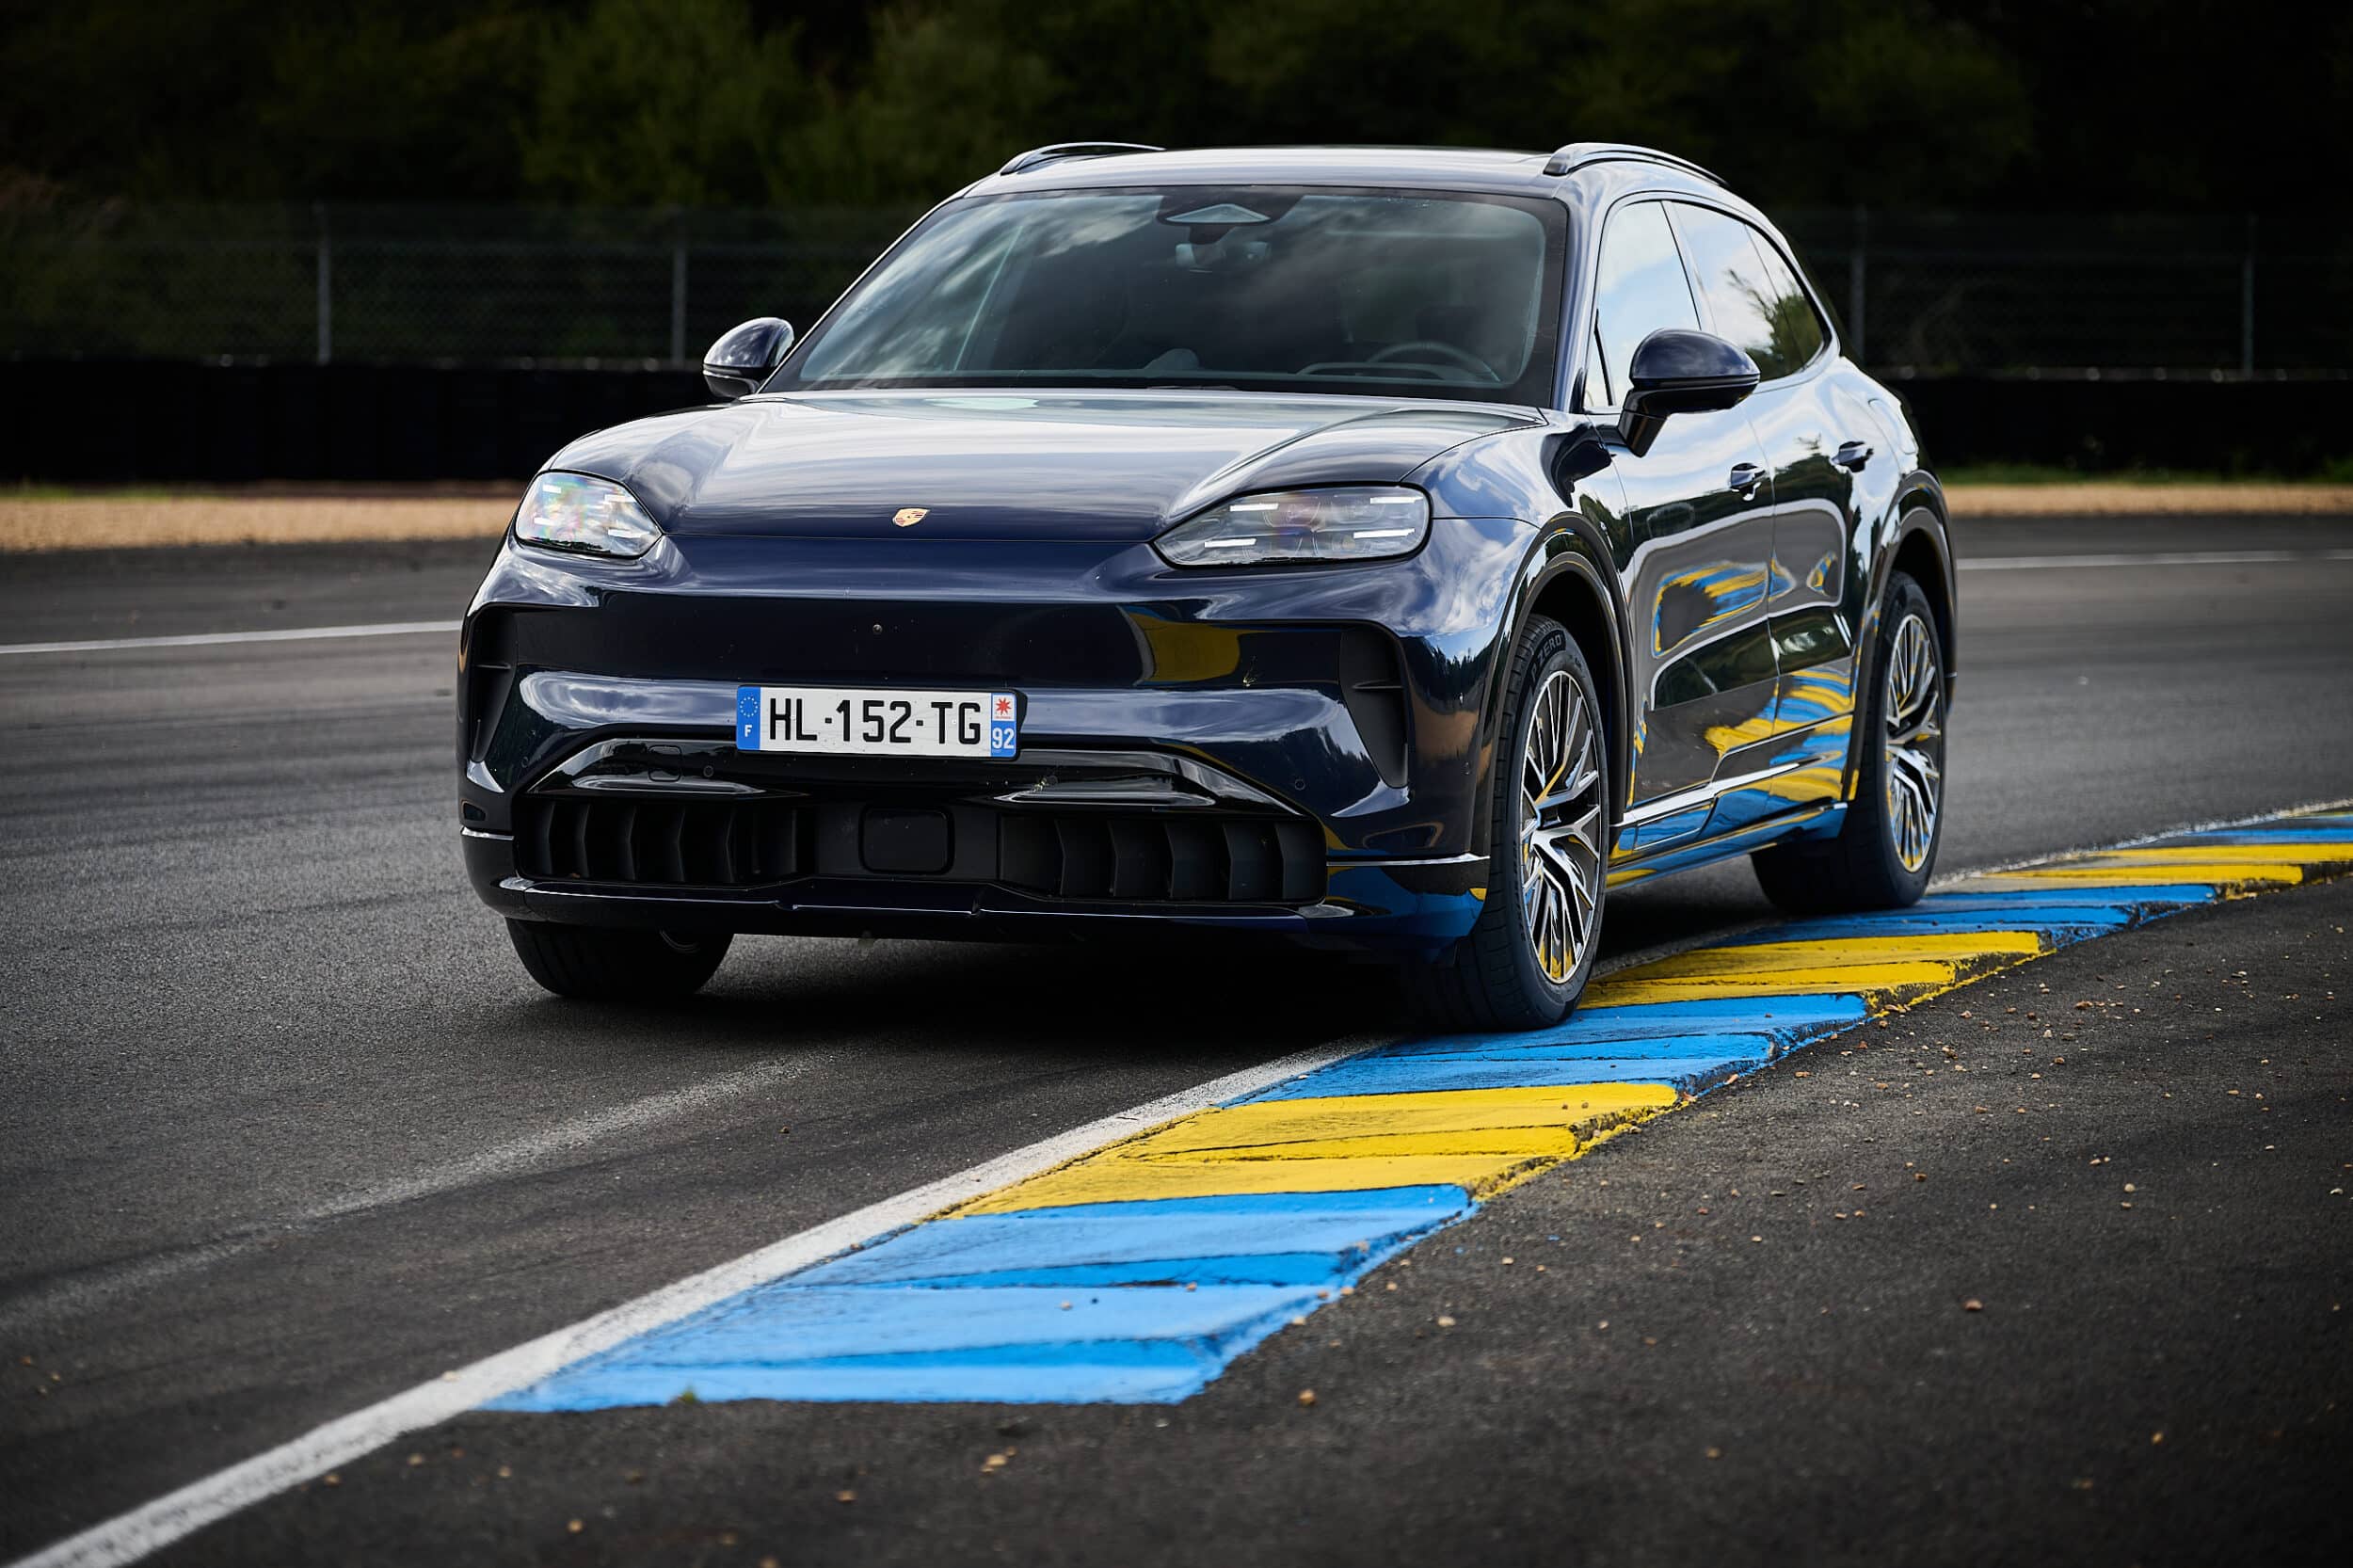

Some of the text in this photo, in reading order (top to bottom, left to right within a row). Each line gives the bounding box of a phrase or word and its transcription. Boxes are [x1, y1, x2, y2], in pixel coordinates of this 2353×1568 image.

[1537, 634, 1562, 665] ZERO
[744, 724, 754, 739] F
[769, 697, 982, 745] HL-152-TG
[991, 727, 1016, 750] 92
